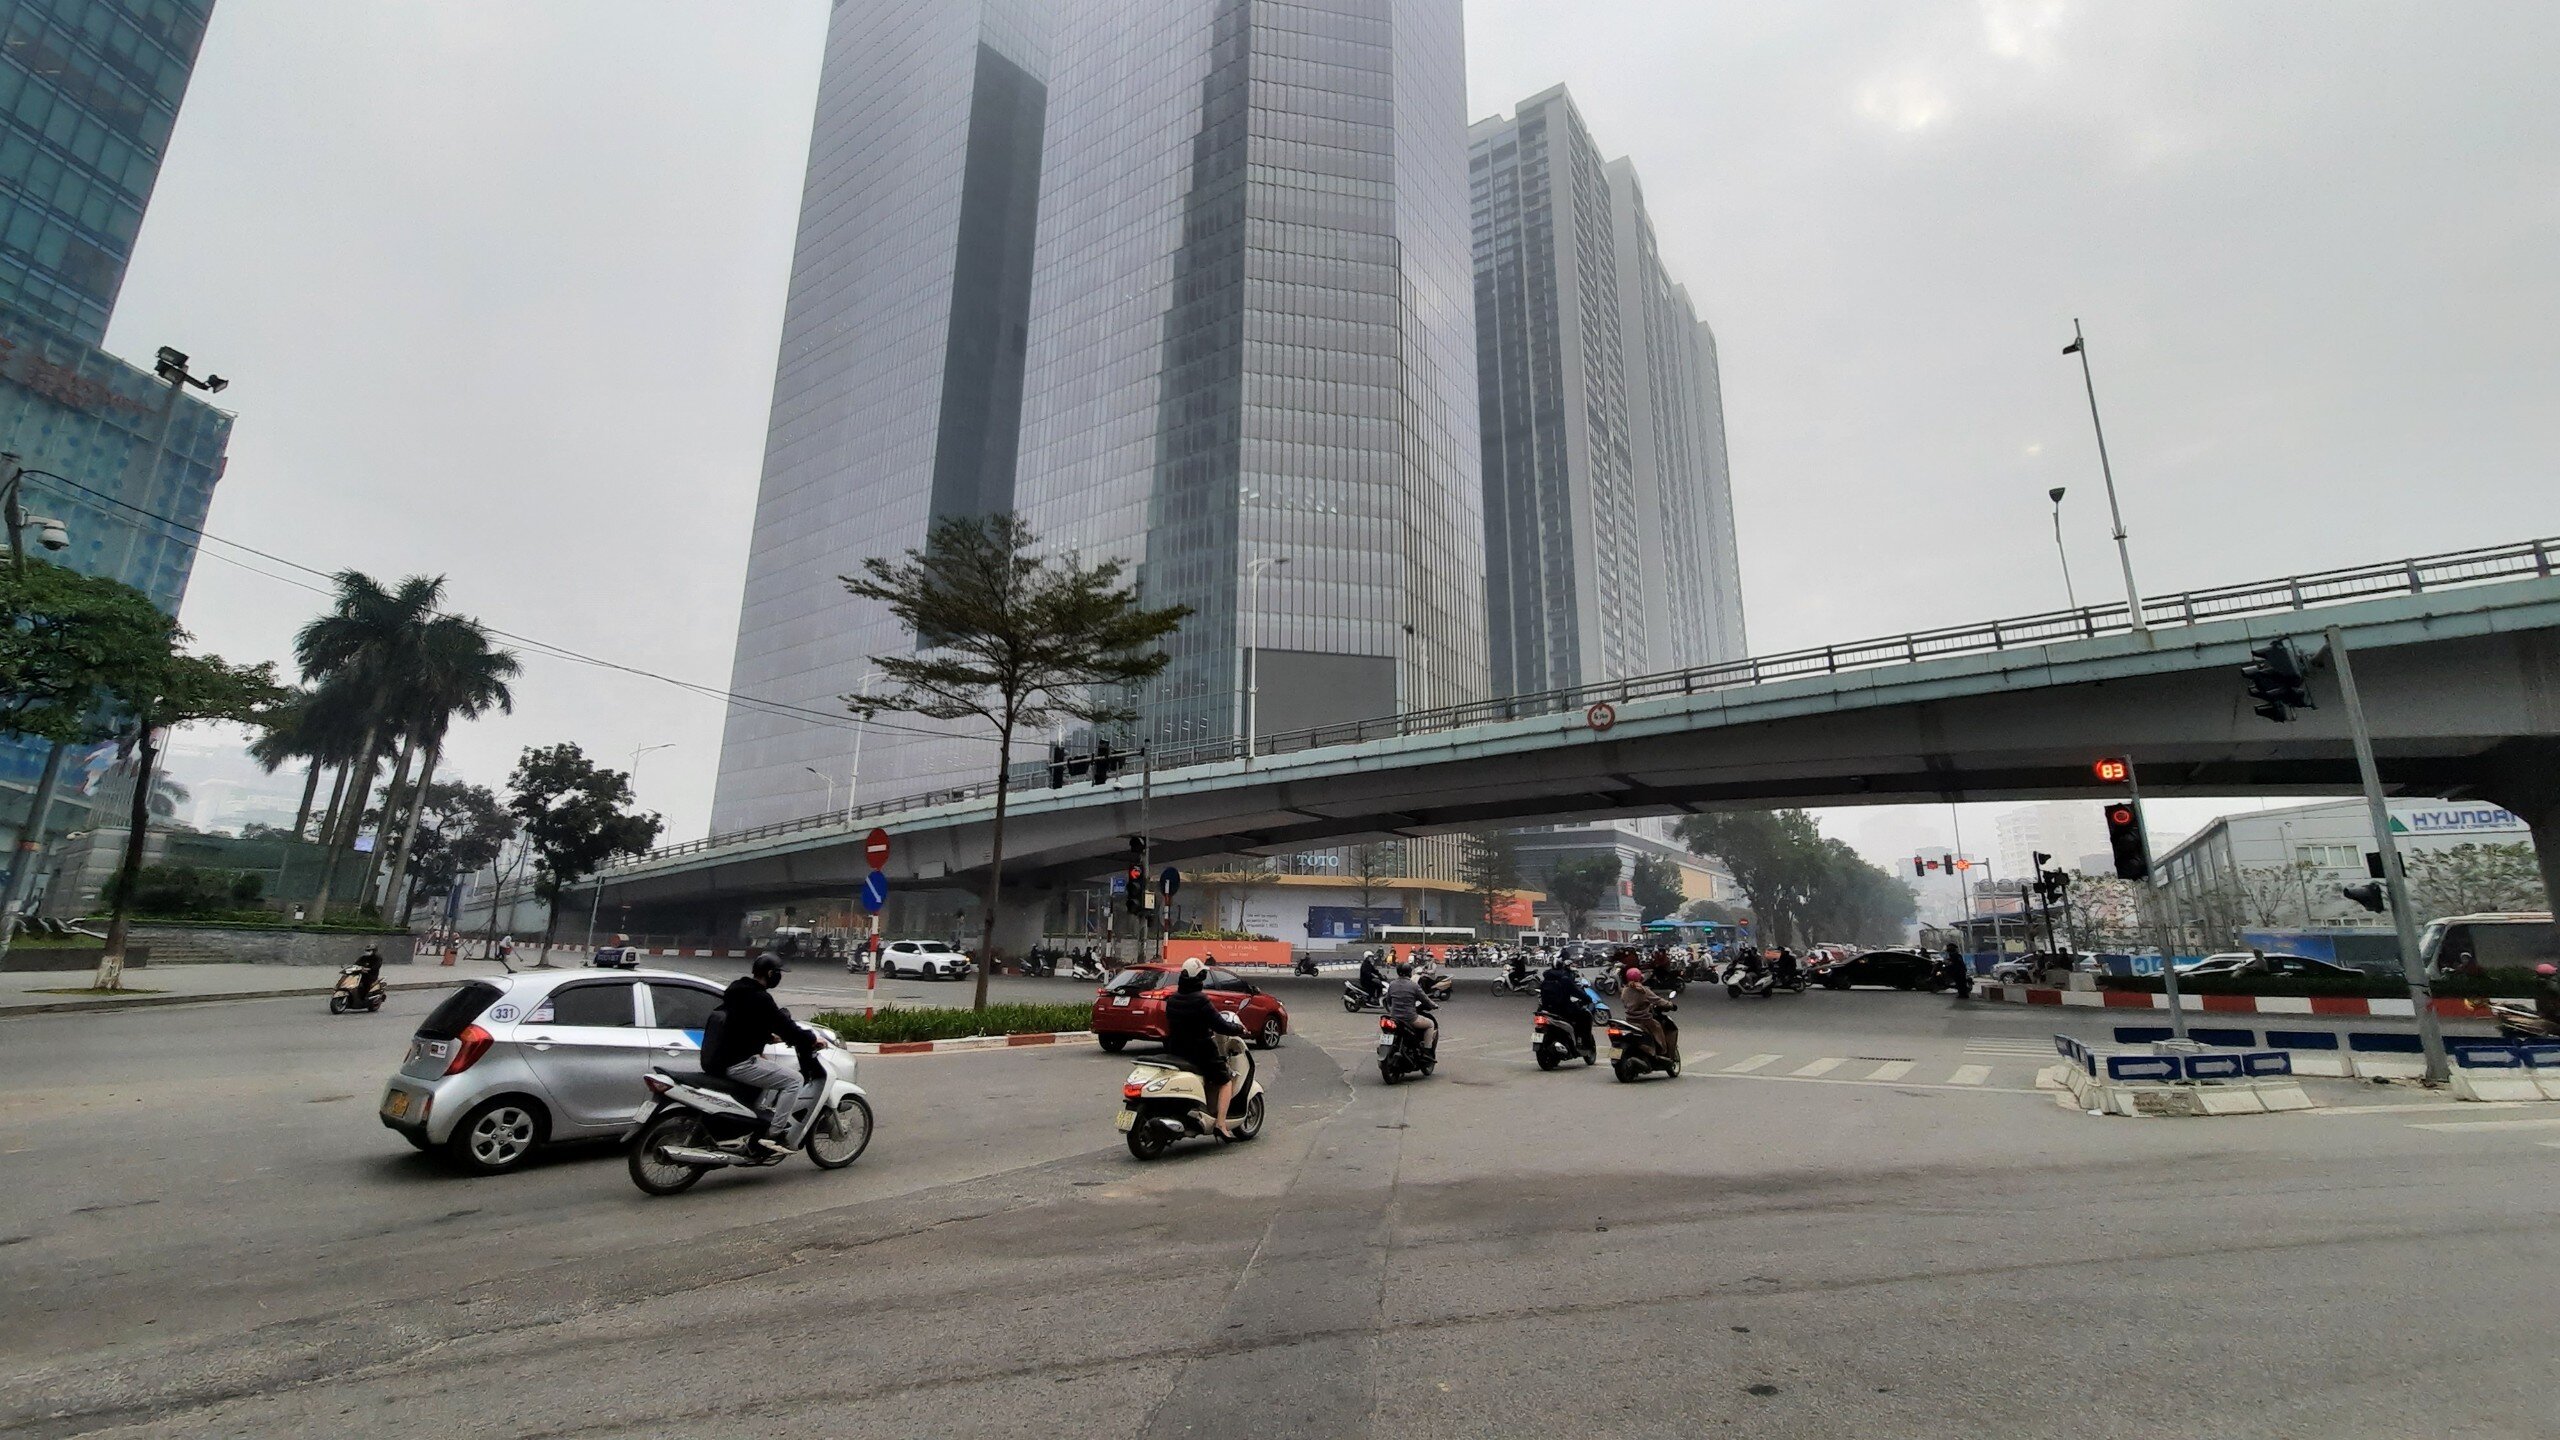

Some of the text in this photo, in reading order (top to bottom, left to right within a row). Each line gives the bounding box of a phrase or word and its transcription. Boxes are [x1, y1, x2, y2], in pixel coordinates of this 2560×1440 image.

[2102, 763, 2124, 779] 83
[1297, 855, 1338, 867] TOTO
[495, 1007, 514, 1019] 331
